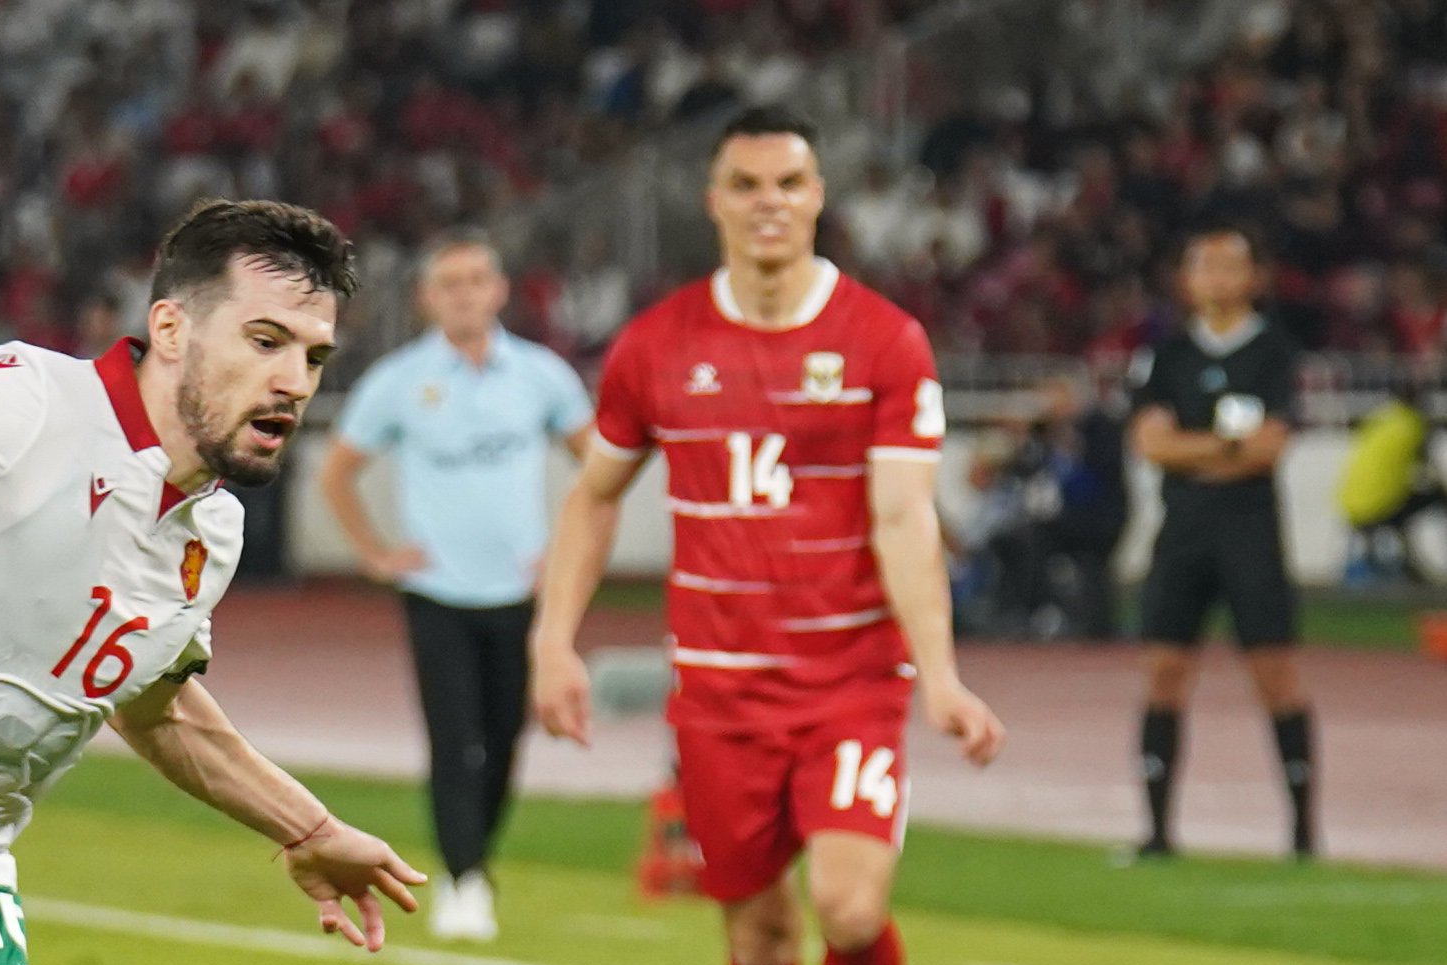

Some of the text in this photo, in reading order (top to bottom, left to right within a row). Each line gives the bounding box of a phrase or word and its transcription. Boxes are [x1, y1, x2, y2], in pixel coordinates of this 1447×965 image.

[728, 431, 794, 509] 14
[51, 586, 149, 698] 16
[830, 739, 897, 818] 14
